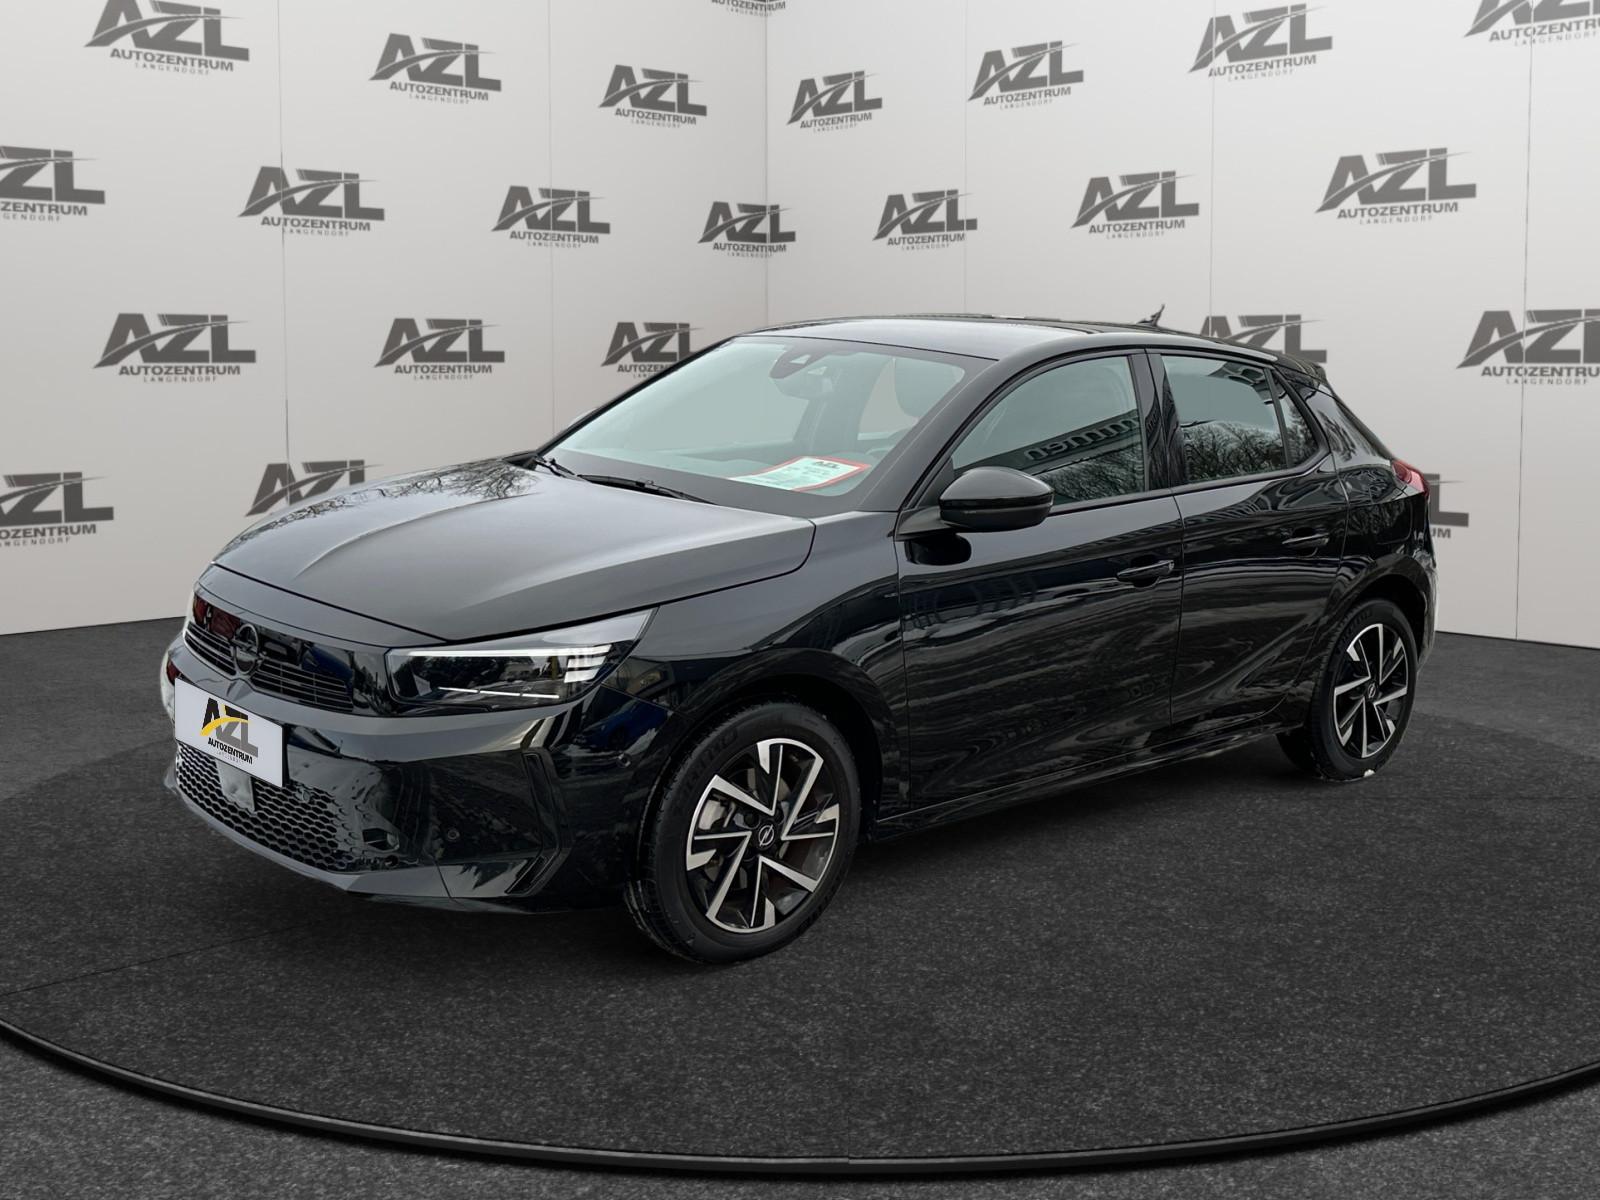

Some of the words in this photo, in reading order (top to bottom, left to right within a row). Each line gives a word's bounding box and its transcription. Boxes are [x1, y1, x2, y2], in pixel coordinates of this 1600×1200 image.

[84, 0, 249, 61] AZL
[1187, 4, 1333, 73] AZL
[110, 48, 233, 72] AUTOZENTRUM
[369, 33, 501, 92] AZL
[968, 40, 1084, 102] AZL
[1208, 54, 1317, 77] AUTOZENTRUM
[389, 81, 489, 101] AUTOZENTRUM
[599, 64, 707, 116] AZL
[787, 70, 883, 126] AZL
[983, 86, 1071, 106] AUTOZENTRUM
[614, 107, 697, 125] AUTOZENTRUM
[800, 112, 872, 129] AUTOZENTRUM
[0, 146, 105, 205] ZL
[238, 166, 385, 221] AZL
[1315, 147, 1476, 214] AZL
[491, 185, 610, 234] AZL
[698, 201, 796, 244] AZL
[872, 189, 978, 241] AZL
[1070, 170, 1199, 229] AZL
[1337, 202, 1459, 219] AUTOZENTRUM
[261, 216, 371, 231] AUTOZENTRUM
[510, 230, 599, 244] AUTOZENTRUM
[887, 233, 965, 246] AUTOZENTRUM
[1088, 219, 1186, 235] AUTOZENTRUM
[713, 242, 787, 253] AUTOZENTRUM
[93, 313, 256, 369] AZL
[374, 317, 505, 368] AZL
[119, 365, 241, 377] AUTOZENTRUM
[394, 364, 493, 374] AUTOZENTRUM
[0, 472, 114, 527] ZL
[200, 697, 258, 758] AZL
[208, 737, 253, 764] AUTOZENTRUM
